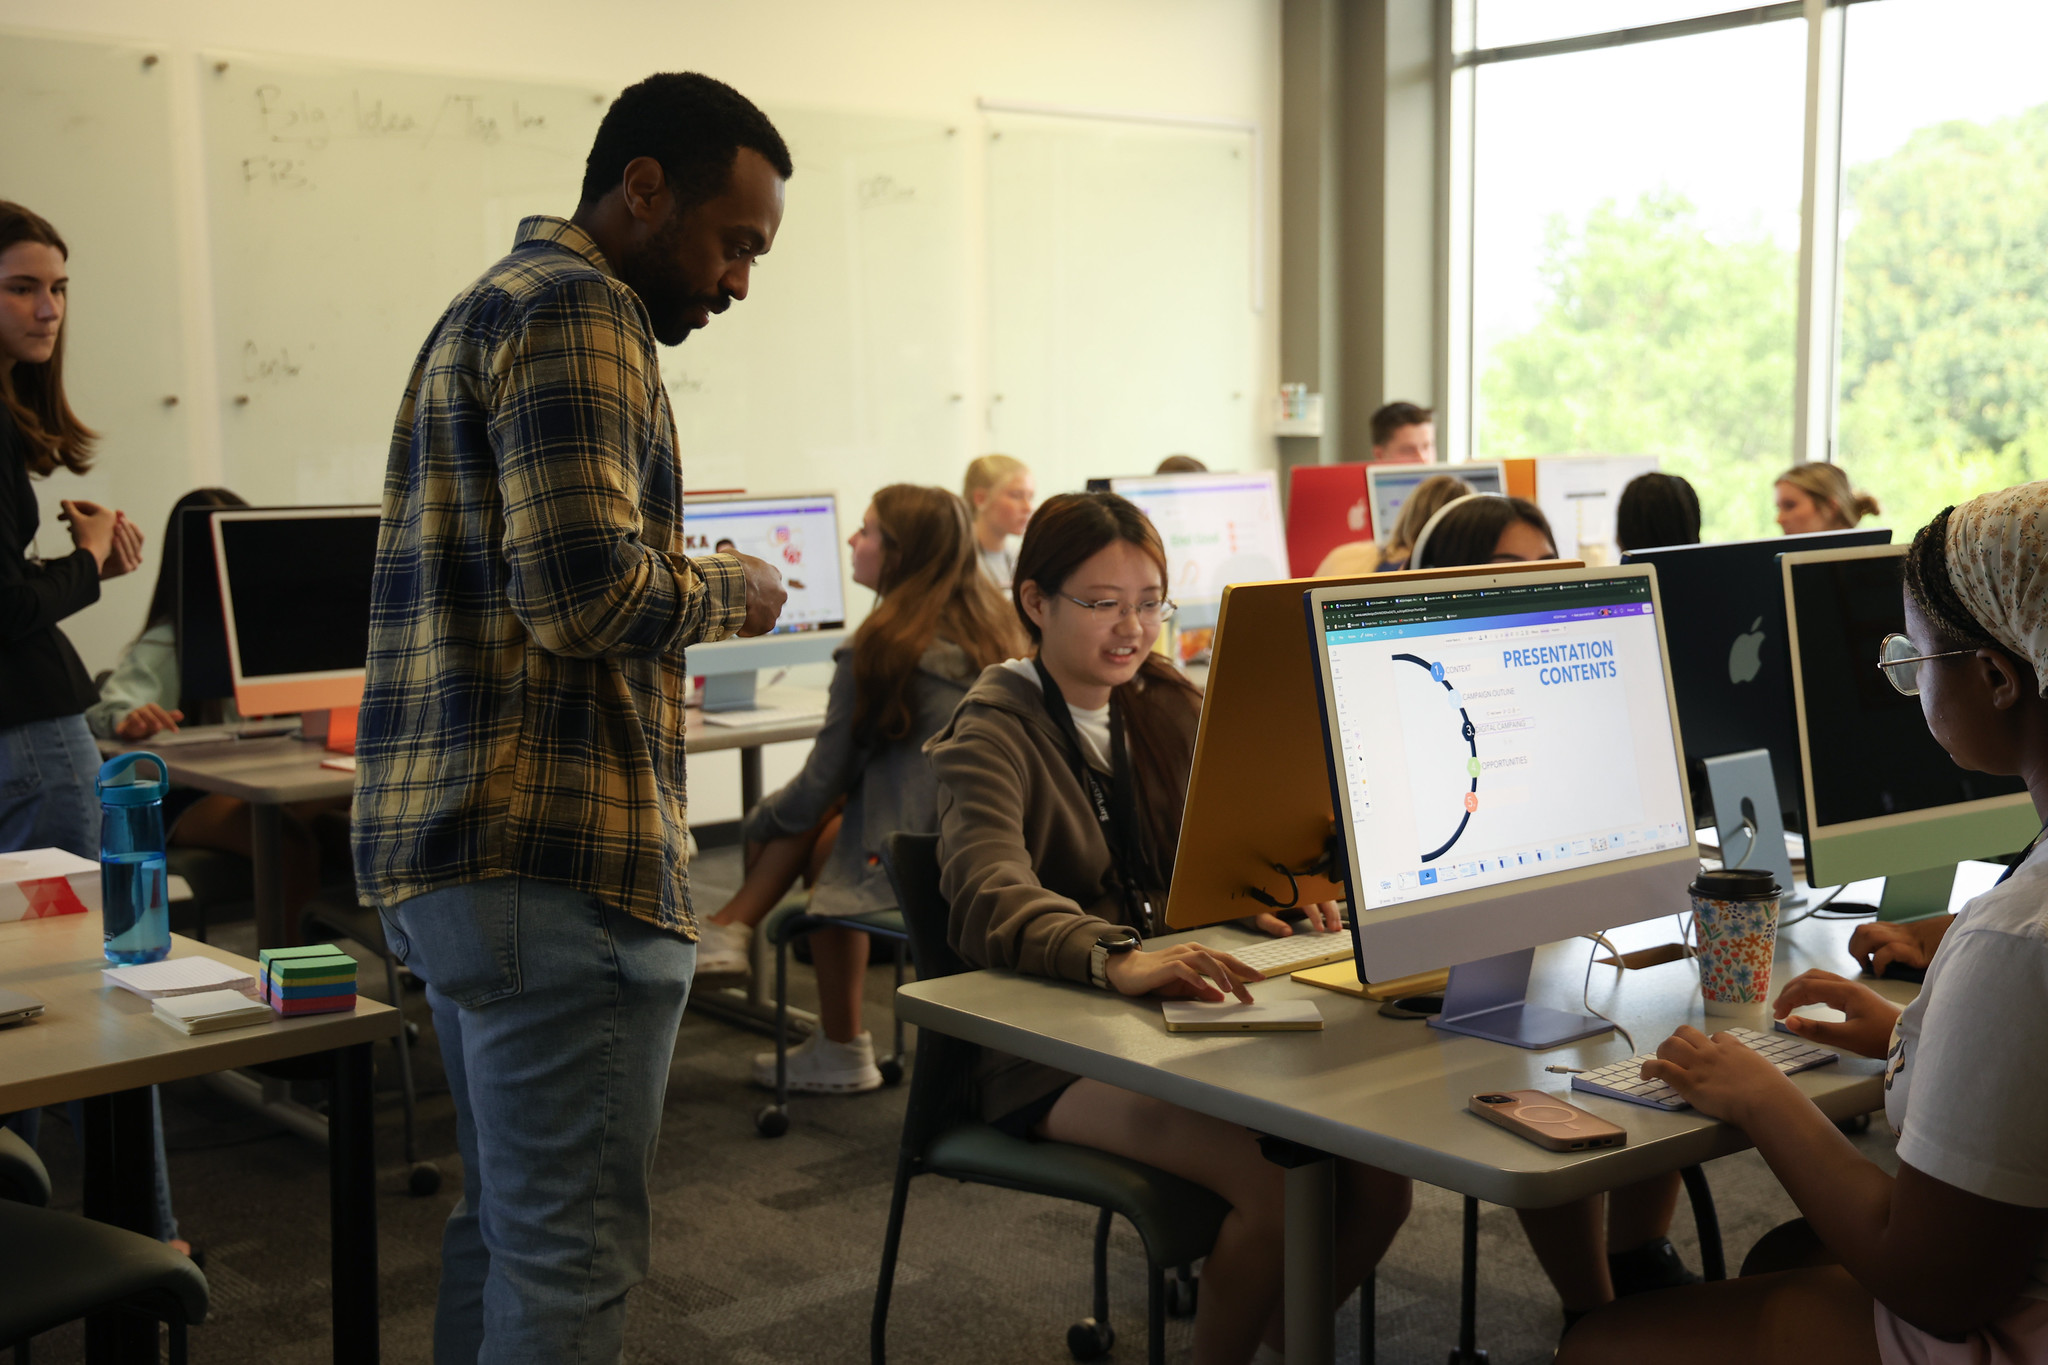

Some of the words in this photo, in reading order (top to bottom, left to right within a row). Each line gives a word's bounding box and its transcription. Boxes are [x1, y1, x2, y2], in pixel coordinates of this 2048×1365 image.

[1503, 640, 1614, 668] PRESENTATION
[1446, 664, 1472, 674] CONTEXT
[1540, 661, 1617, 685] CONTENTS
[1462, 690, 1492, 700] CAMPAIGN
[1492, 687, 1516, 697] OUTLINE
[1481, 756, 1528, 770] OPPORTUNITIES
